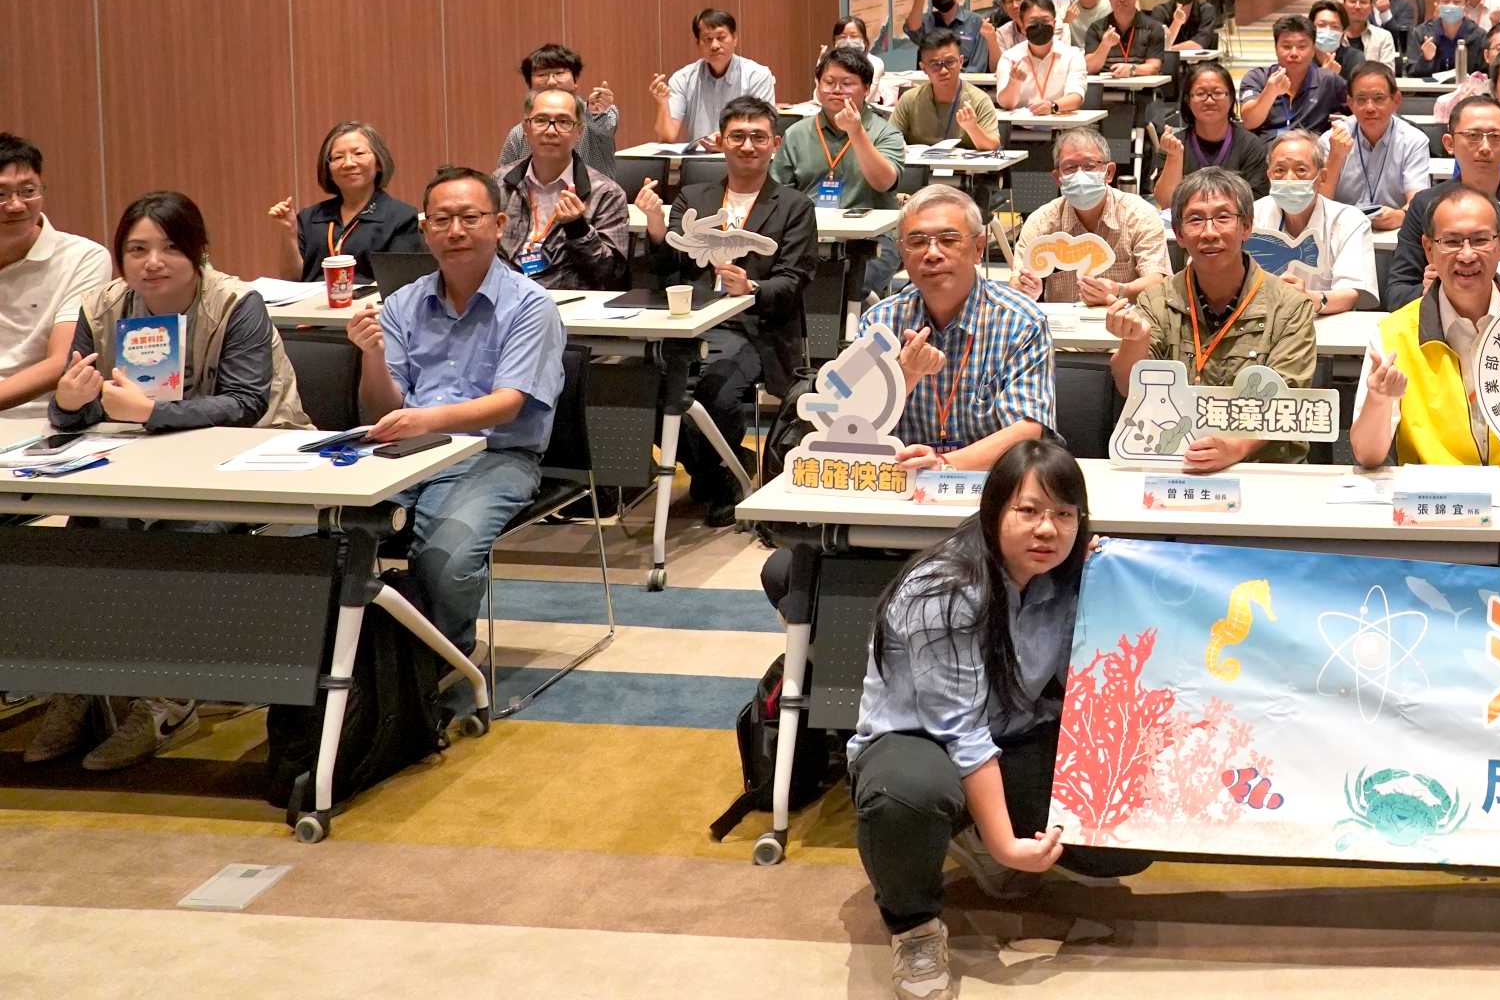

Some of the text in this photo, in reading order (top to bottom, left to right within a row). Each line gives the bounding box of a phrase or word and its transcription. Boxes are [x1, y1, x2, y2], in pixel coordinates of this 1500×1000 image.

[1196, 395, 1333, 434] 海藻保健
[793, 457, 907, 493] 精確快篩
